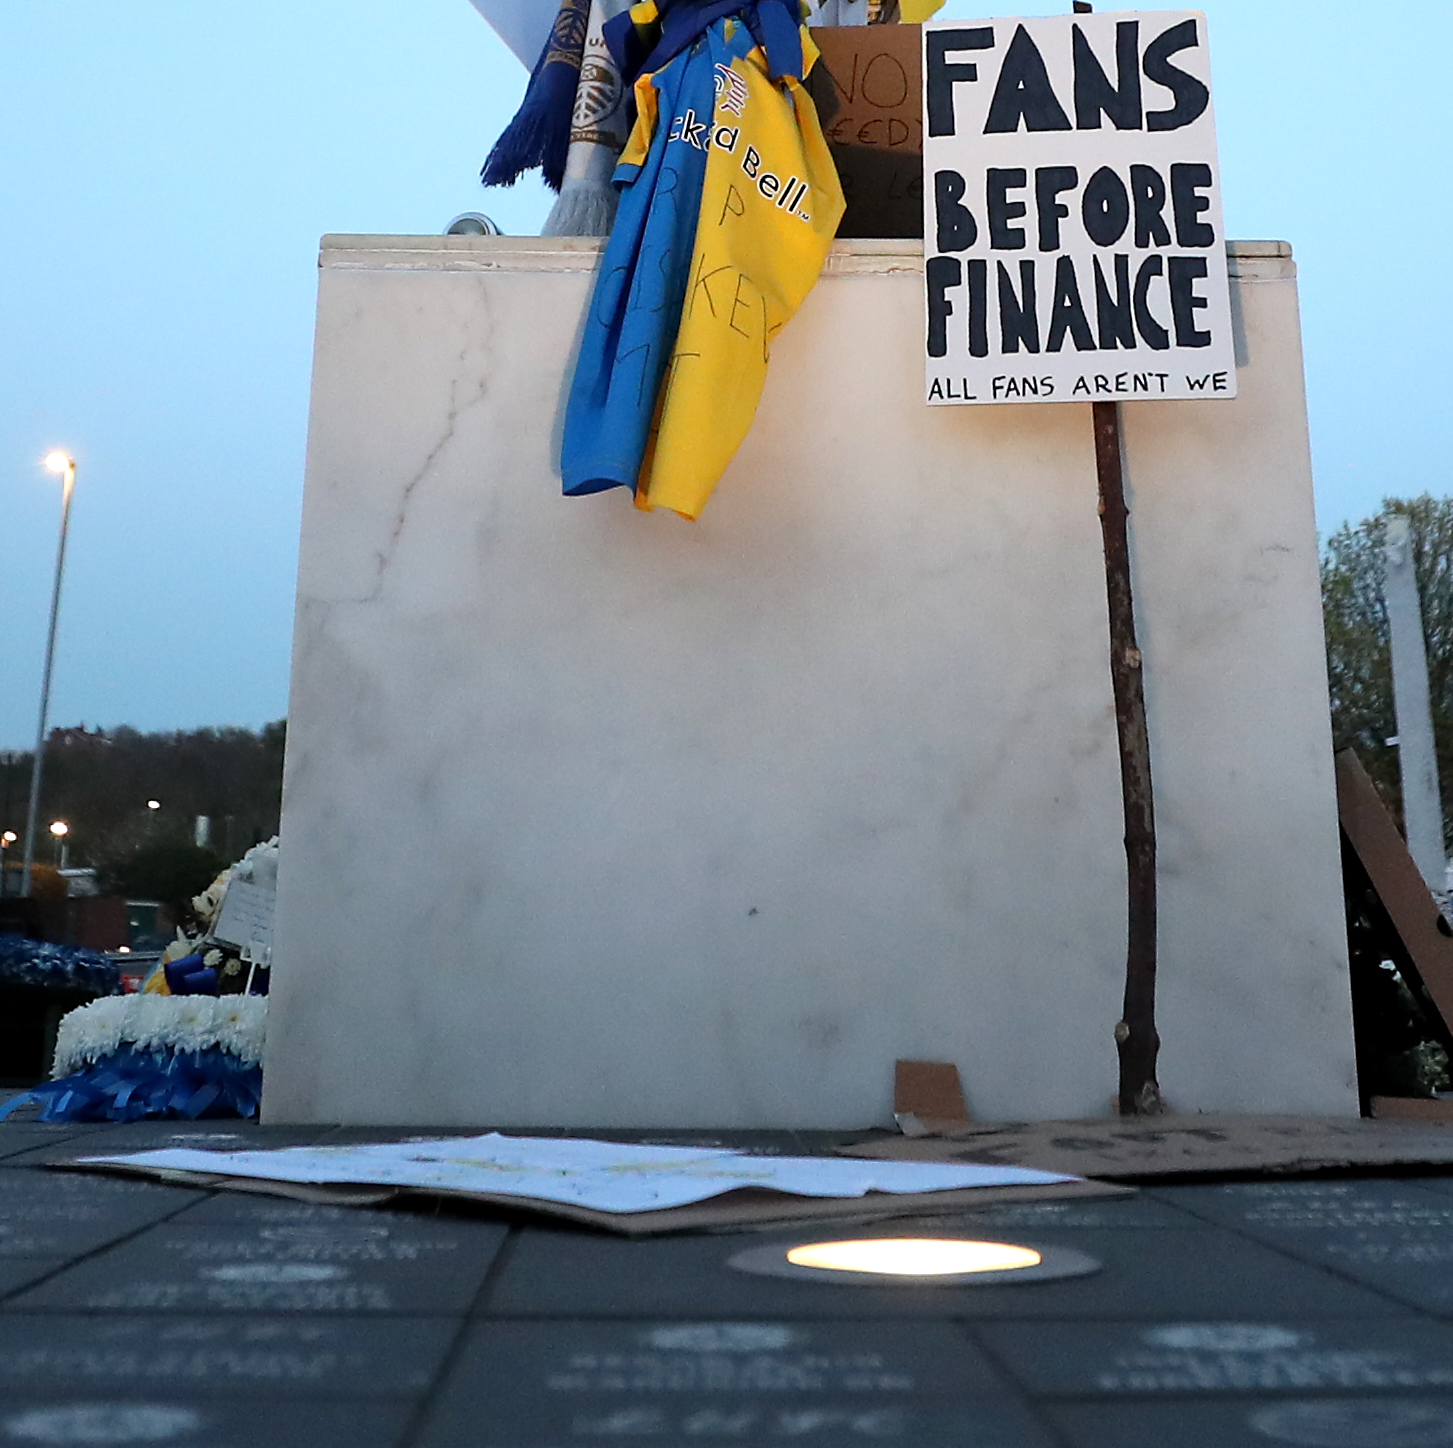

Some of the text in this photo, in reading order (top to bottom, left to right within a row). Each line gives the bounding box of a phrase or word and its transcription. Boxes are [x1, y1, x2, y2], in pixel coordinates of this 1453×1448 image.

[812, 52, 908, 109] NO
[925, 19, 1210, 138] FANS
[741, 144, 808, 215] Bell
[934, 163, 1215, 254] BEFORE
[925, 253, 1212, 359] FINANCE
[928, 371, 1228, 401] ALL FANS AREN'T WE
